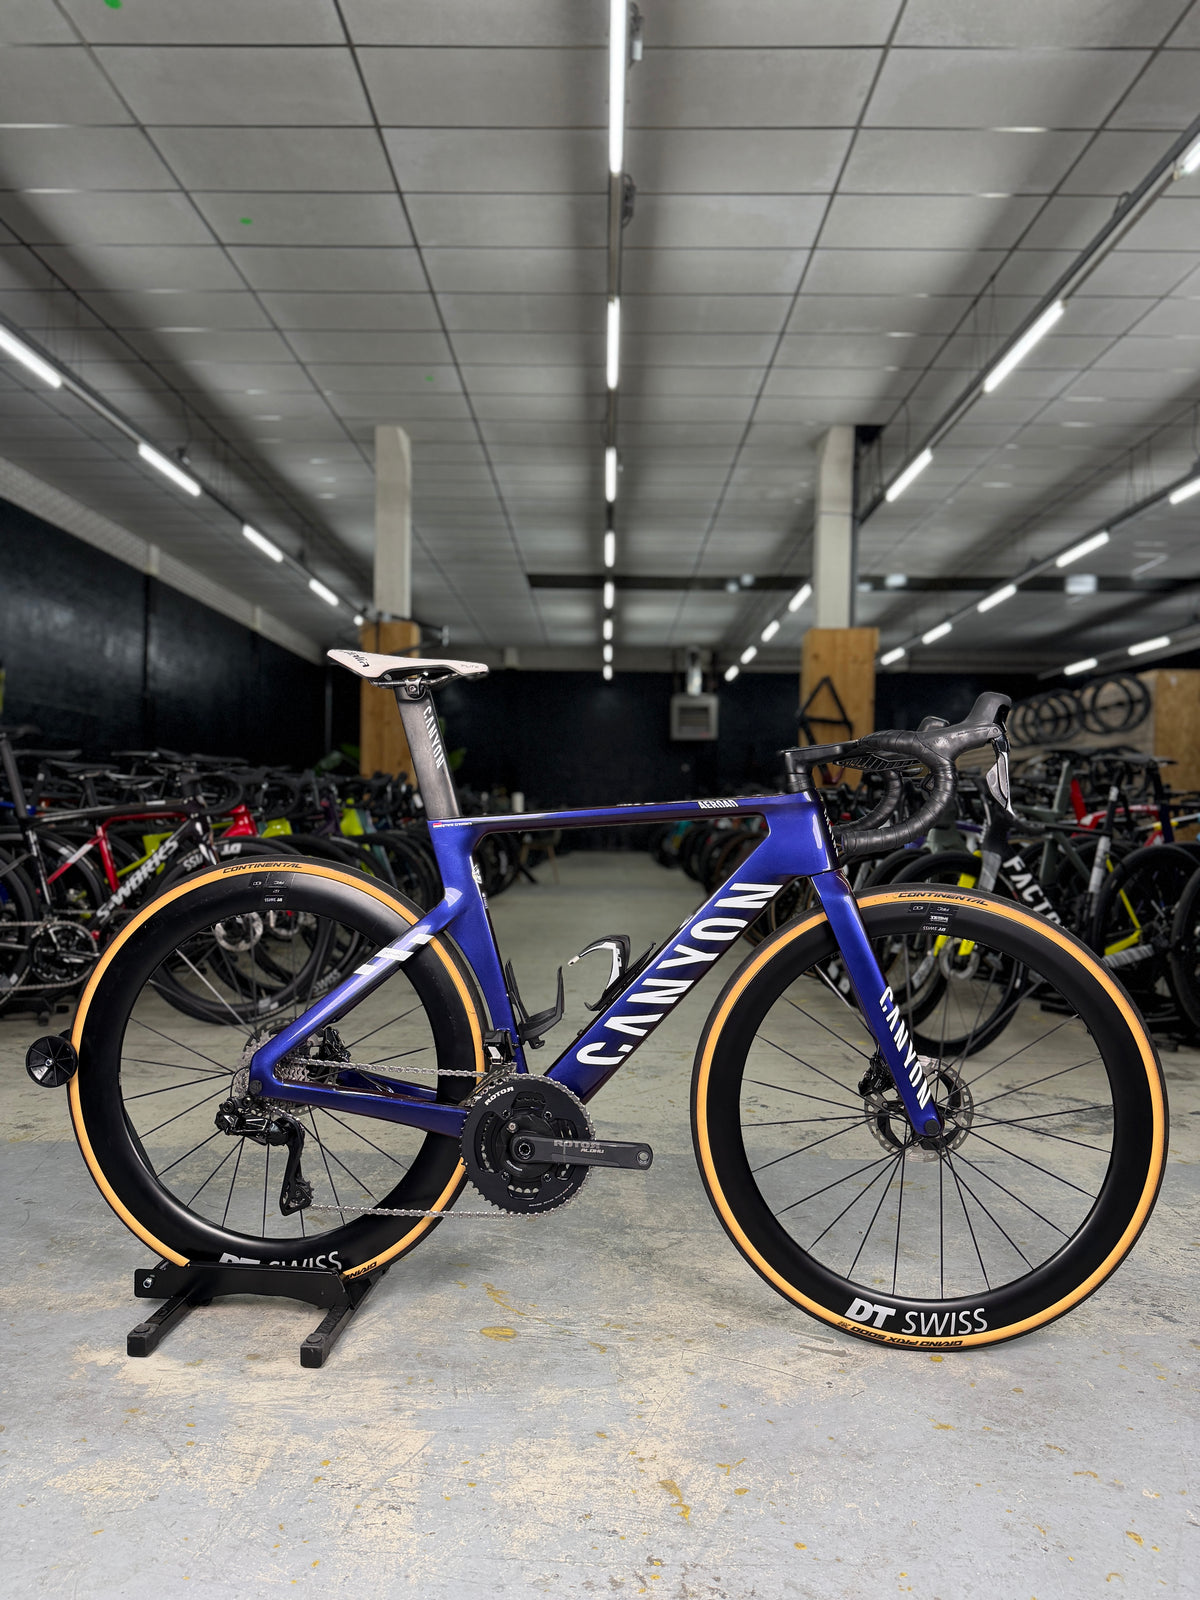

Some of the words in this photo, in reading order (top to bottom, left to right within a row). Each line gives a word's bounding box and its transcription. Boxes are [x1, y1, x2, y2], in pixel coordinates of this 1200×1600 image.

[423, 705, 446, 769] CANYON
[698, 799, 739, 809] AEROAD
[222, 862, 303, 875] CONTINENTAL
[96, 837, 180, 925] S-WORKS
[897, 891, 989, 907] CONTINENTAL
[575, 882, 784, 1066] CANYON
[879, 985, 932, 1110] CANYON
[484, 1086, 515, 1106] ROTOR
[553, 1139, 602, 1149] ROTOR
[844, 1297, 897, 1329] DT
[901, 1307, 989, 1337] SWISS
[850, 1326, 886, 1341] 5000
[887, 1335, 919, 1347] PRIX
[919, 1339, 964, 1347] GRAND
